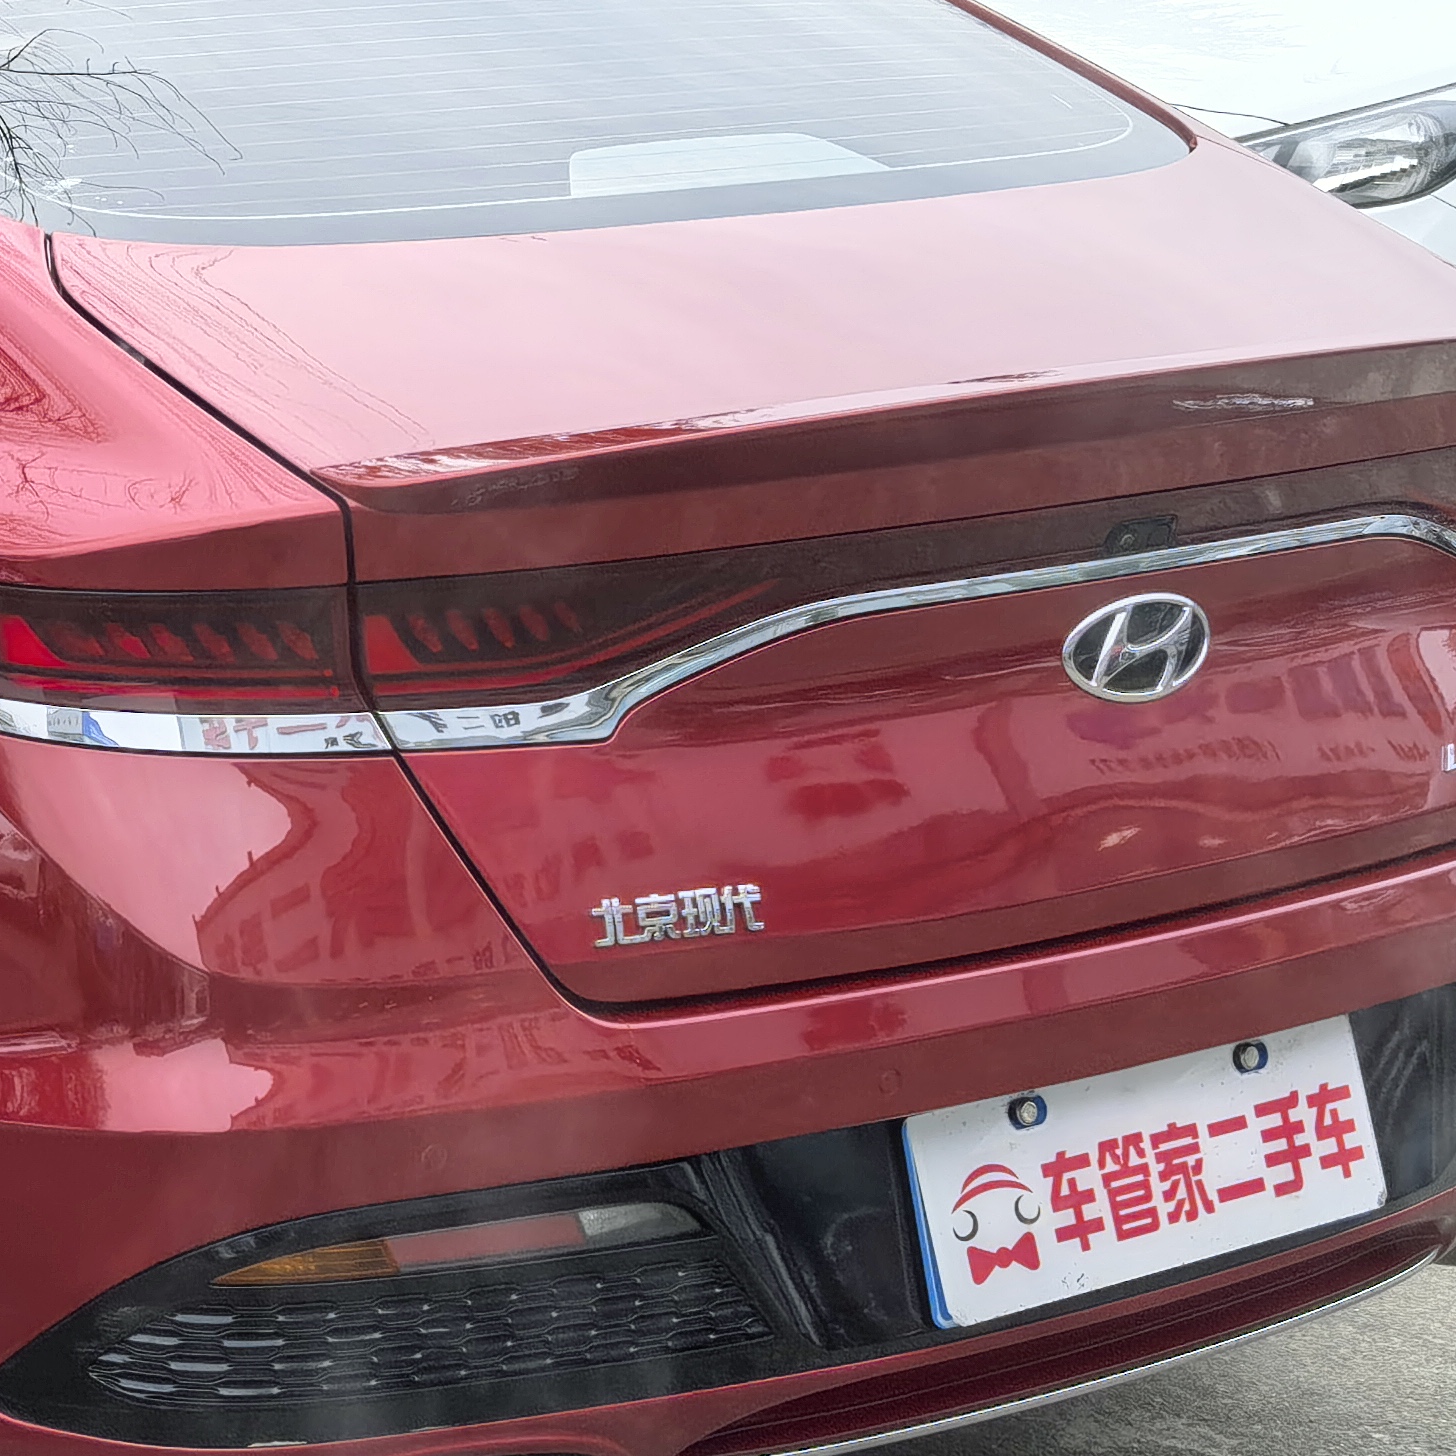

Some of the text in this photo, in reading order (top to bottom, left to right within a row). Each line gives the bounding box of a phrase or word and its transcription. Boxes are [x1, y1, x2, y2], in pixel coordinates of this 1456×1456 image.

[591, 883, 765, 948] 北京现代
[1040, 1081, 1365, 1252] 车管家二手车
